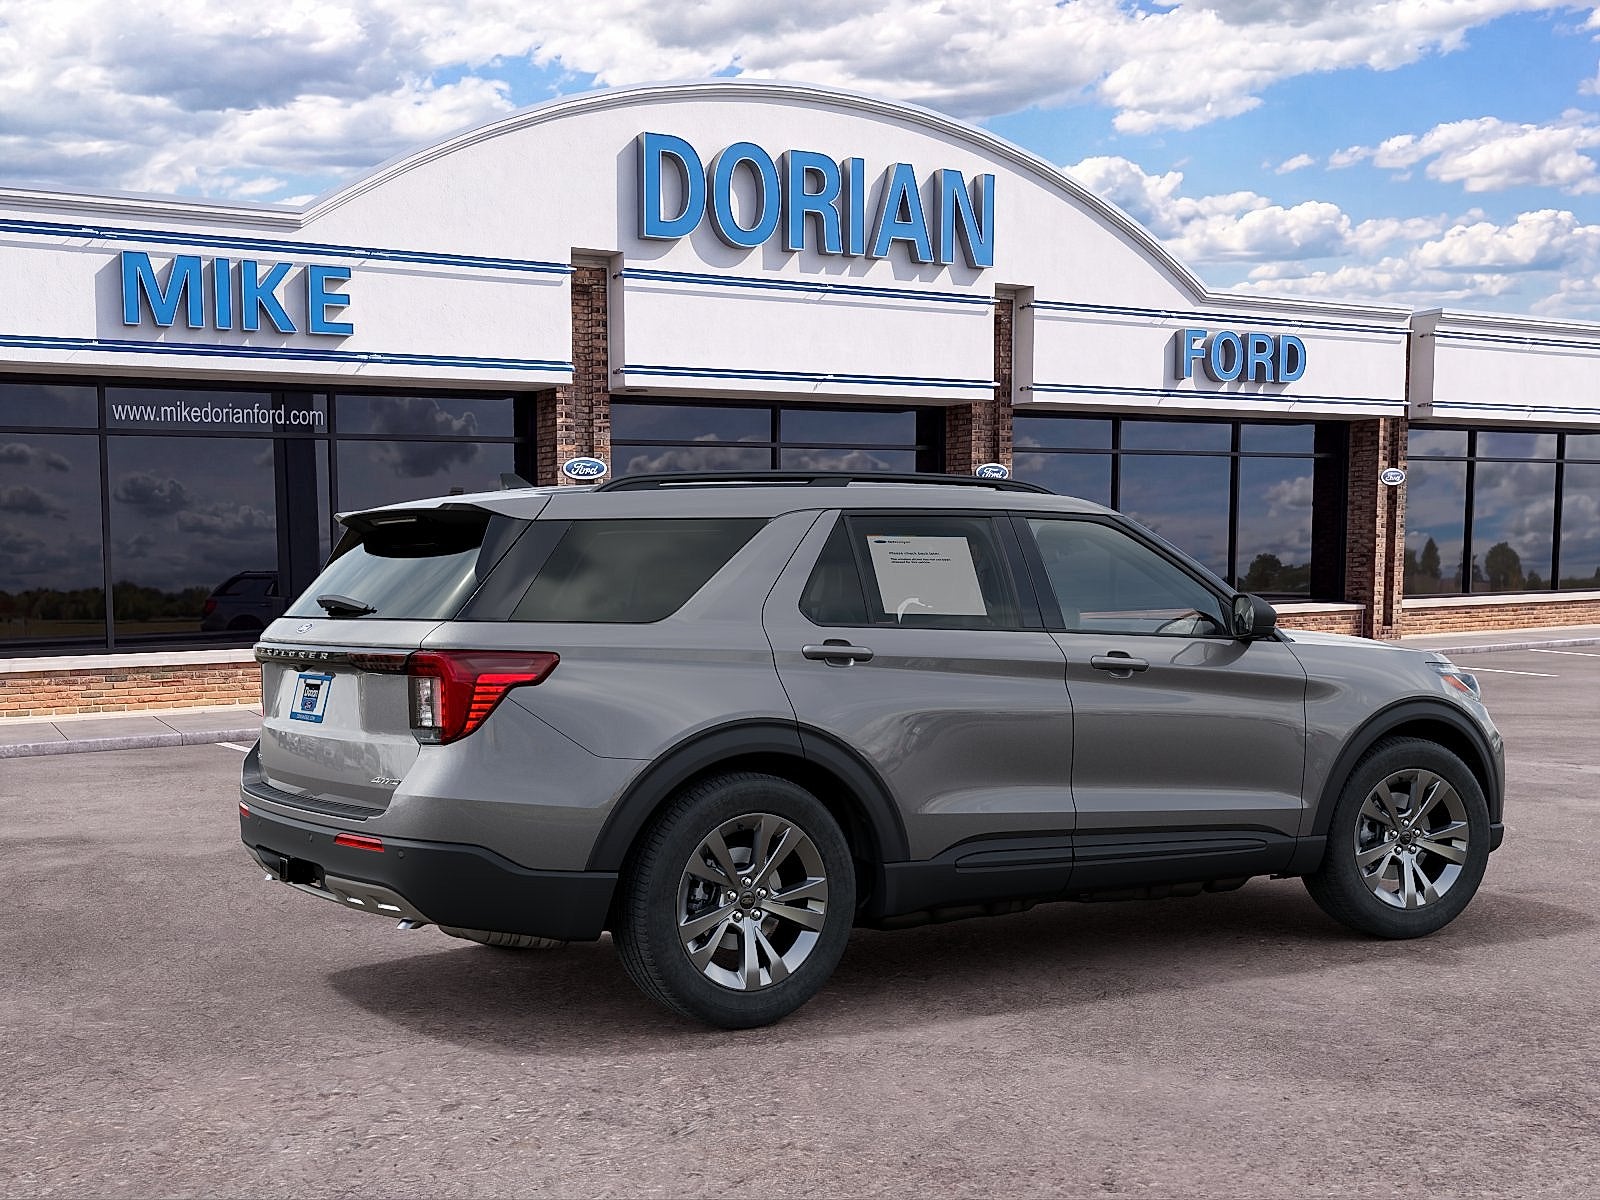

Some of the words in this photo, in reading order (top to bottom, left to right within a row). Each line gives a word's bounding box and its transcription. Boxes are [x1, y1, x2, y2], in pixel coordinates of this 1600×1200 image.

[637, 131, 996, 268] DORIAN
[121, 250, 354, 336] MIKE
[1175, 328, 1307, 383] FORD
[112, 401, 324, 426] www.mikedorianford.com
[260, 648, 329, 660] EXPLORER
